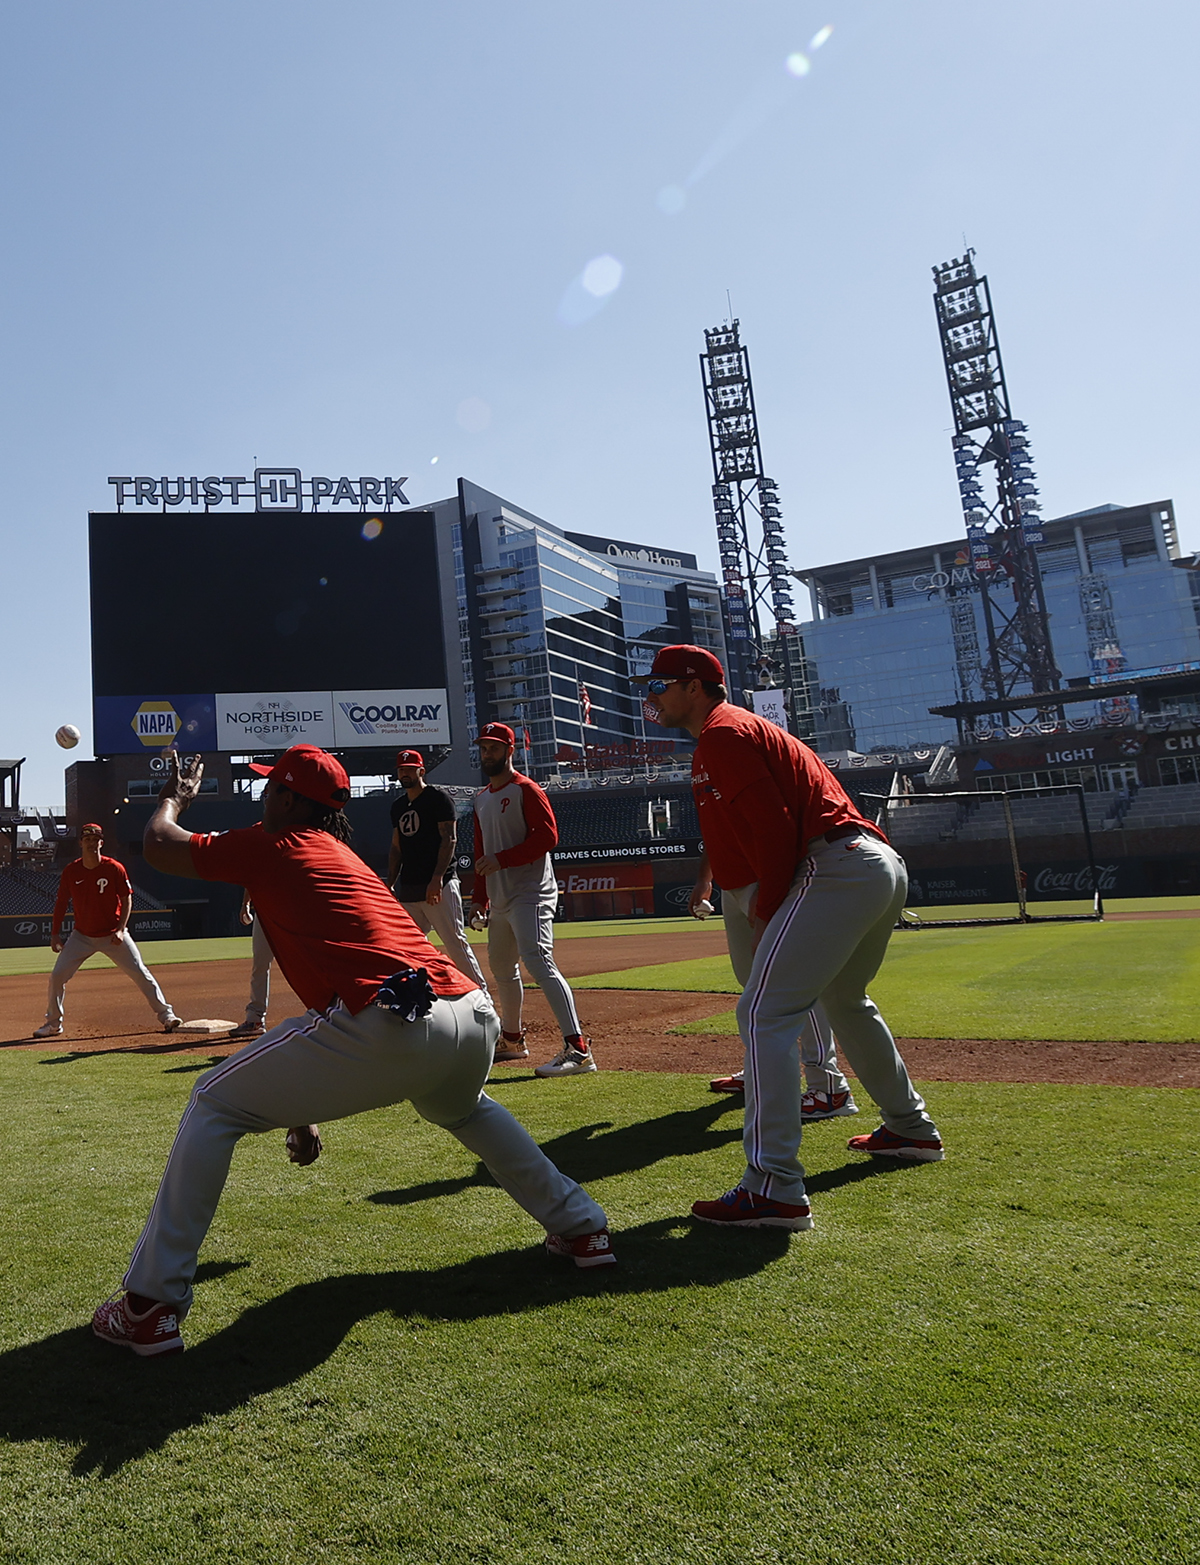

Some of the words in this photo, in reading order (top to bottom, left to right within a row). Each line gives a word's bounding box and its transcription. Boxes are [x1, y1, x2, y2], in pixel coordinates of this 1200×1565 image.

[108, 477, 246, 506] TRUIST
[311, 477, 410, 505] PARK
[1020, 501, 1036, 510] 2012
[970, 530, 987, 538] 2013
[1025, 533, 1043, 542] 2020
[607, 543, 637, 560] OMNI
[975, 561, 991, 570] 2021
[731, 615, 745, 623] 1991
[349, 704, 442, 723] COOLRAY
[762, 703, 777, 712] EAT
[226, 710, 324, 724] NORTHSIDE
[762, 712, 780, 720] MOR
[139, 715, 174, 734] NAPA
[244, 725, 307, 734] HOSPITAL
[630, 739, 675, 755] Farm
[1046, 748, 1095, 764] LIGHT
[401, 812, 415, 833] 21
[554, 851, 589, 860] BRAVES
[591, 848, 647, 858] CLUBHOUSE
[649, 845, 686, 854] STORES
[557, 874, 615, 893] eFarm
[927, 880, 956, 888] KAISER
[928, 888, 988, 899] PERMANENTE
